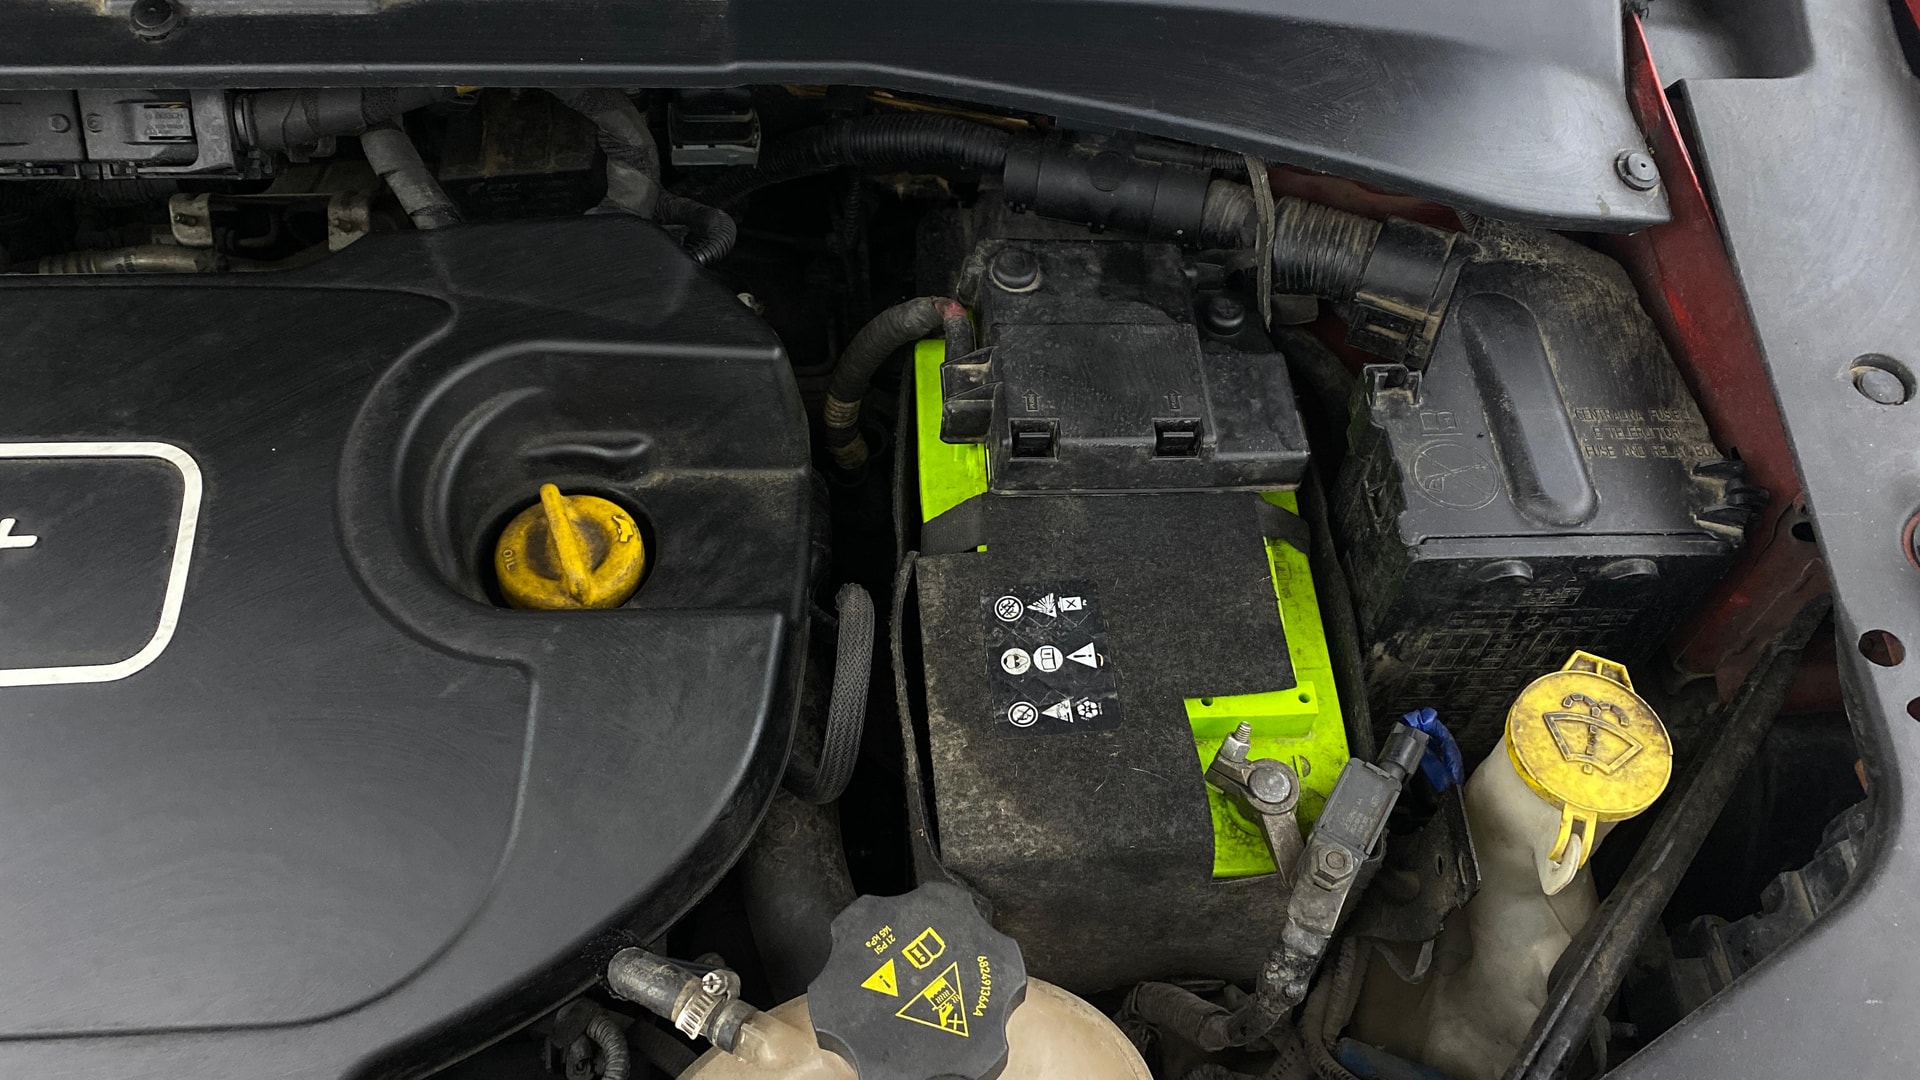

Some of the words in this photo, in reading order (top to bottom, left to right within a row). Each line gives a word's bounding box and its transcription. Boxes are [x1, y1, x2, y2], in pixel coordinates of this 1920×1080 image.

[1574, 408, 1645, 421] CENTRALINA
[1592, 426, 1603, 440] E
[1584, 444, 1617, 459] FUSE
[1622, 444, 1647, 459] AND
[1651, 443, 1689, 459] RELAY
[1691, 443, 1723, 459] BOX
[503, 549, 515, 571] OIL
[879, 924, 892, 938] 145
[865, 933, 881, 948] kPa
[885, 933, 896, 945] 21
[874, 940, 889, 955] PSI
[972, 955, 992, 1017] 68249136AA
